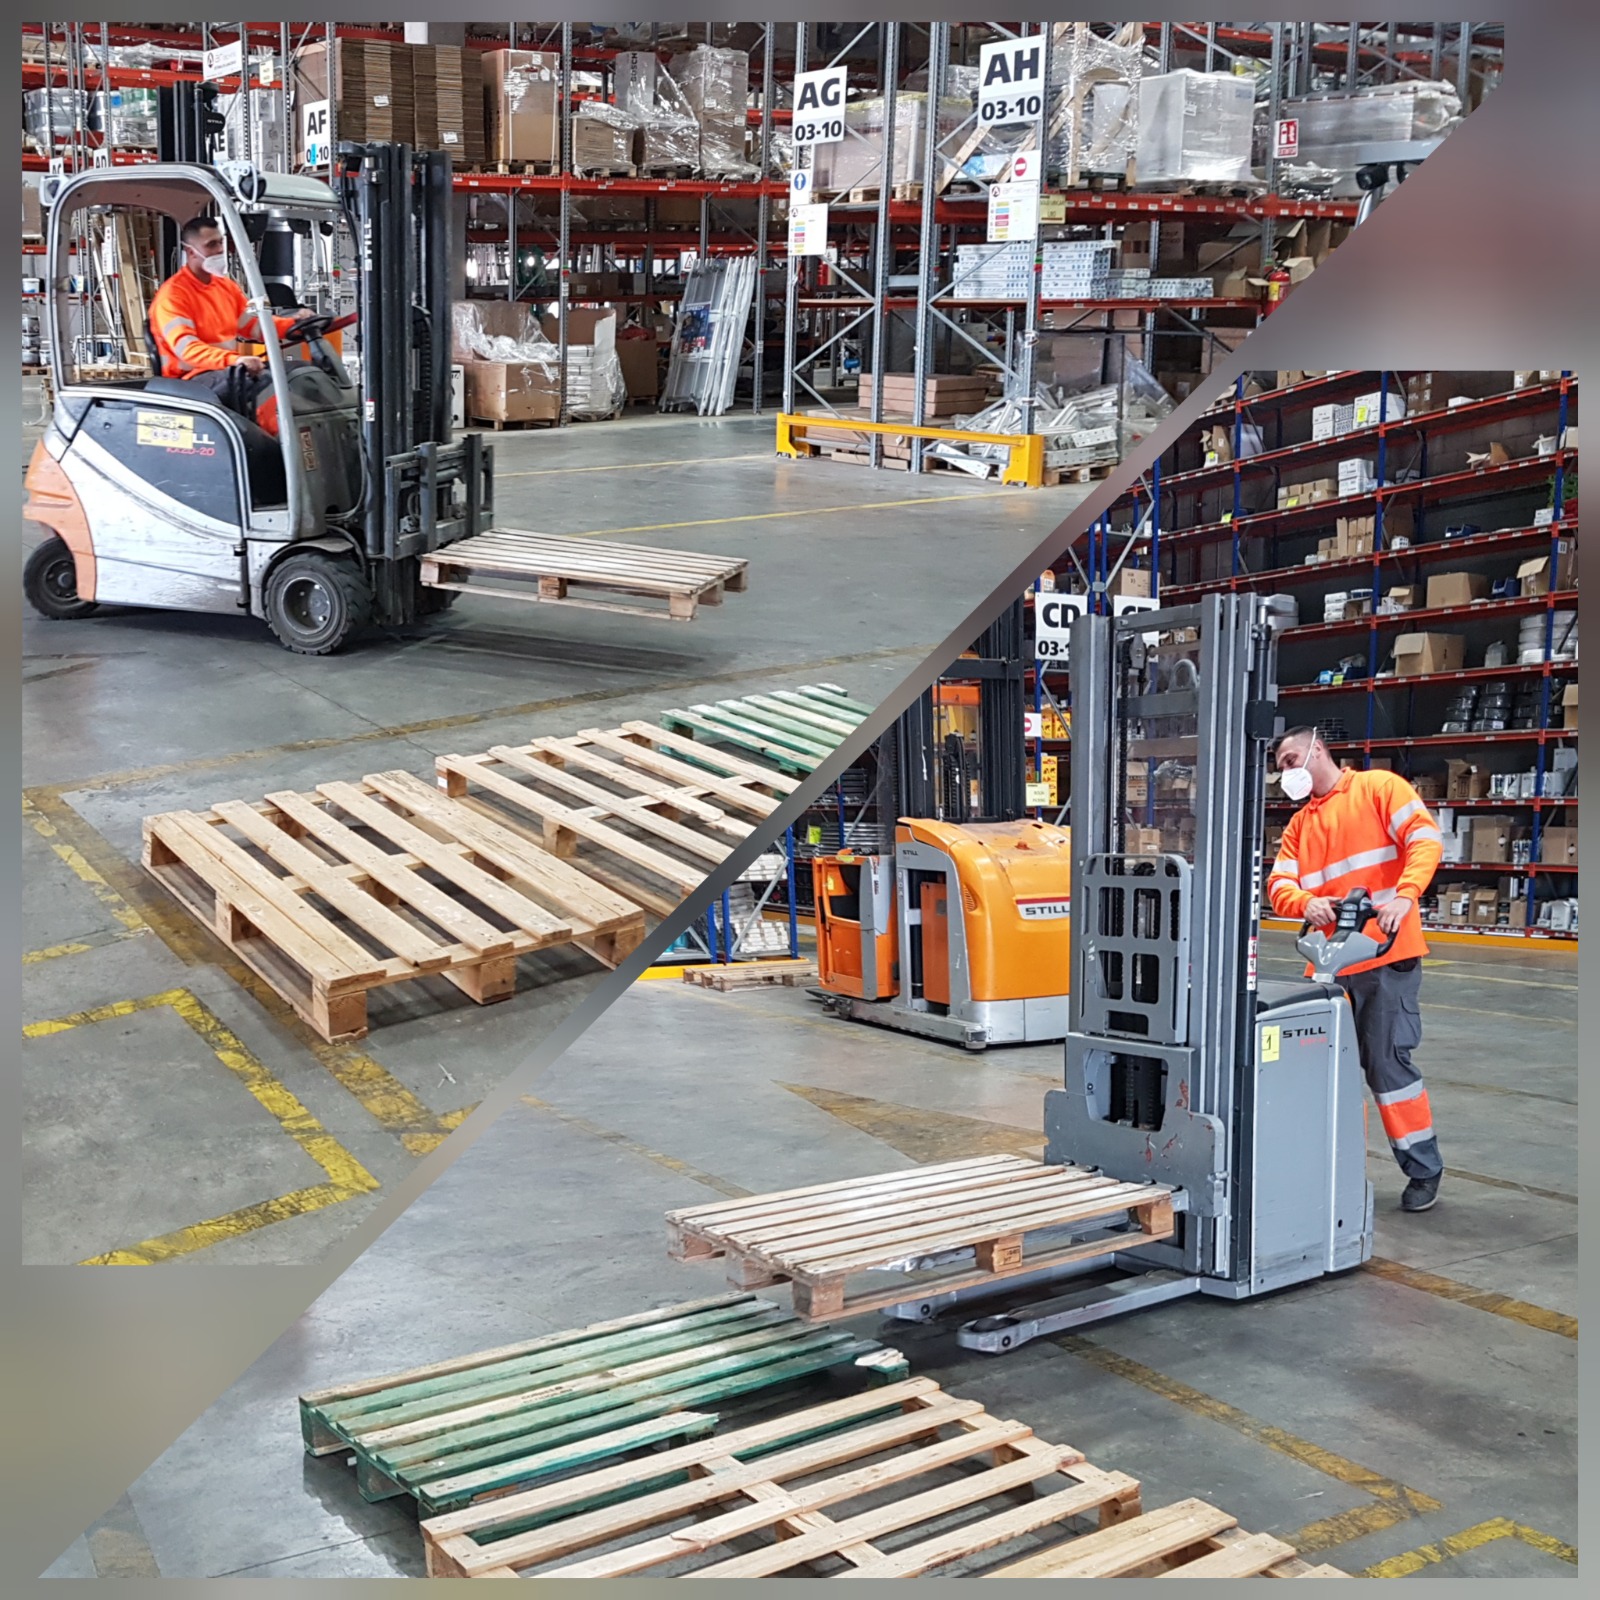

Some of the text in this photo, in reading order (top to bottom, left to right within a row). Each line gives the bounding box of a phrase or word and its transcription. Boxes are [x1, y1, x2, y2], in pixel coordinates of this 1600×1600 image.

[982, 47, 1040, 87] AH
[797, 77, 841, 112] AG
[981, 95, 1041, 121] 03-10
[307, 109, 327, 137] AF
[794, 120, 842, 142] 03-10
[364, 218, 373, 272] STILL
[1042, 602, 1082, 628] CD
[1025, 904, 1070, 916] STILL
[1282, 1026, 1327, 1038] STILL
